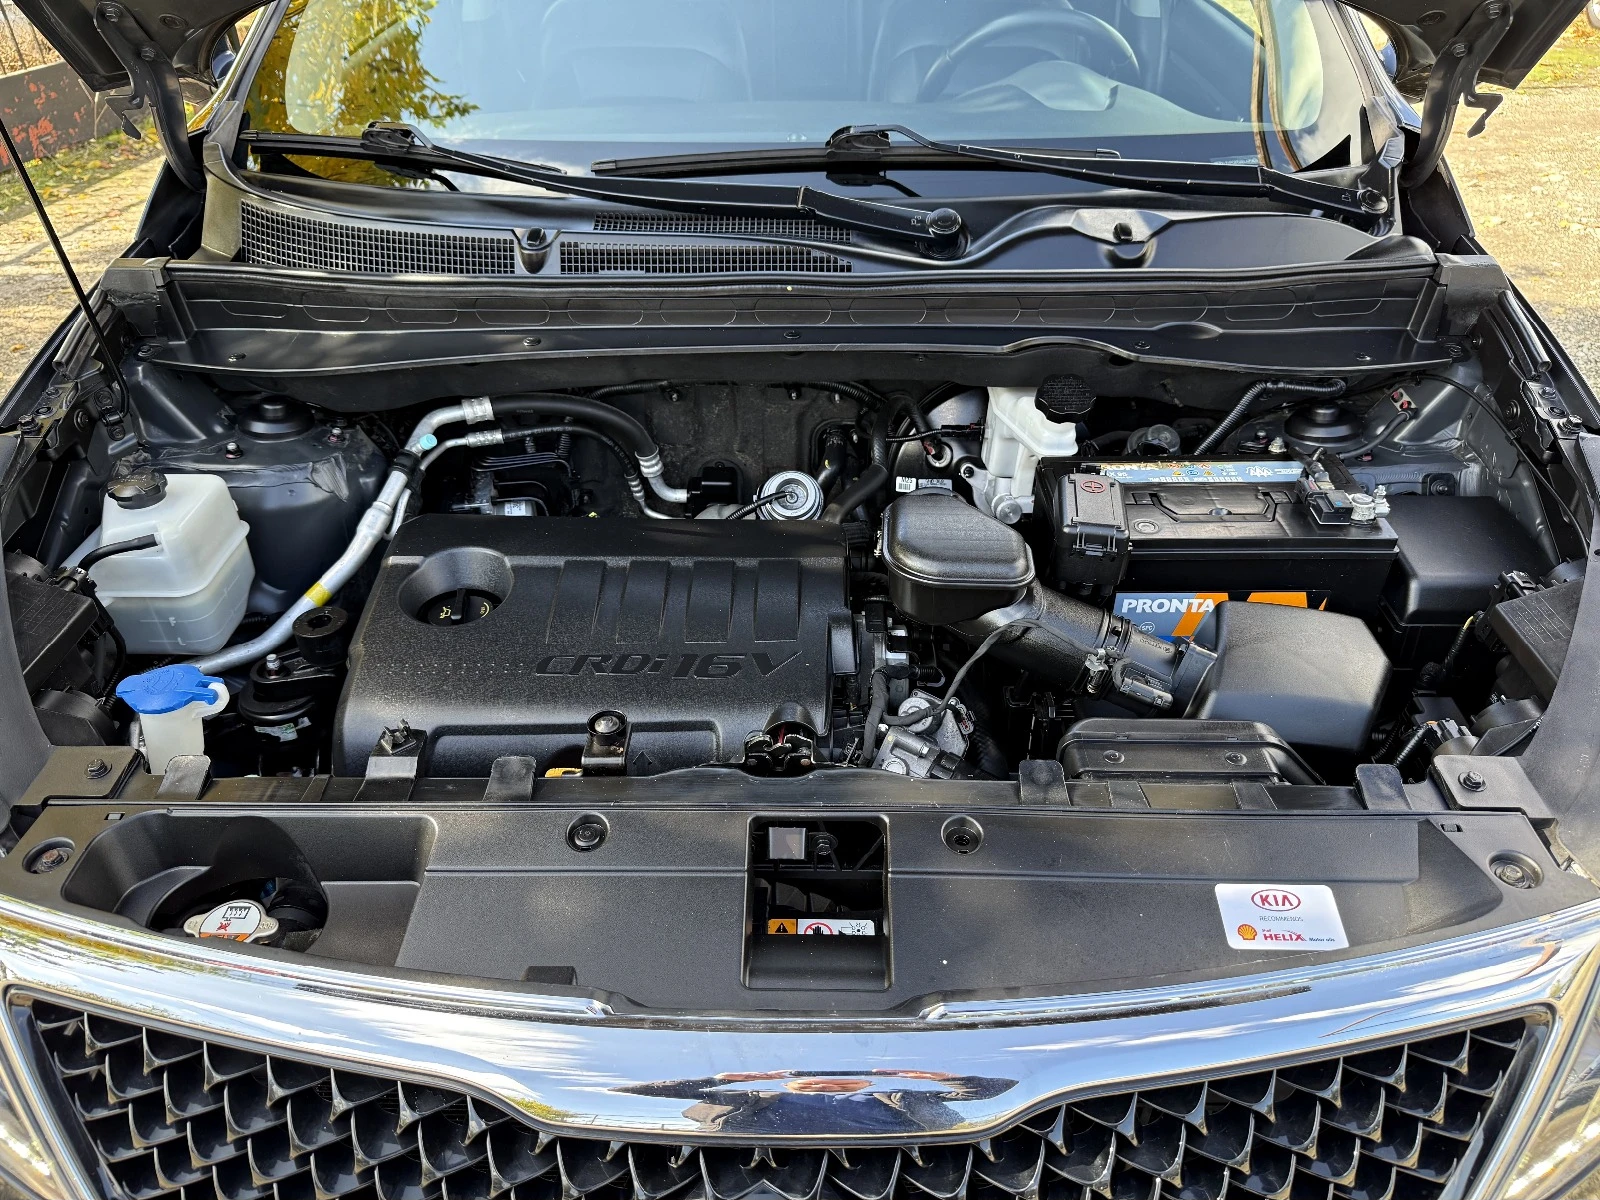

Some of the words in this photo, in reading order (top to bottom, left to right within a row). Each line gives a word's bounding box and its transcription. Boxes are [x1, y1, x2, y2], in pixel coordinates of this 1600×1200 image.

[1121, 598, 1215, 613] PRONTA
[1260, 894, 1294, 907] KIA
[1263, 933, 1308, 942] HELIX
